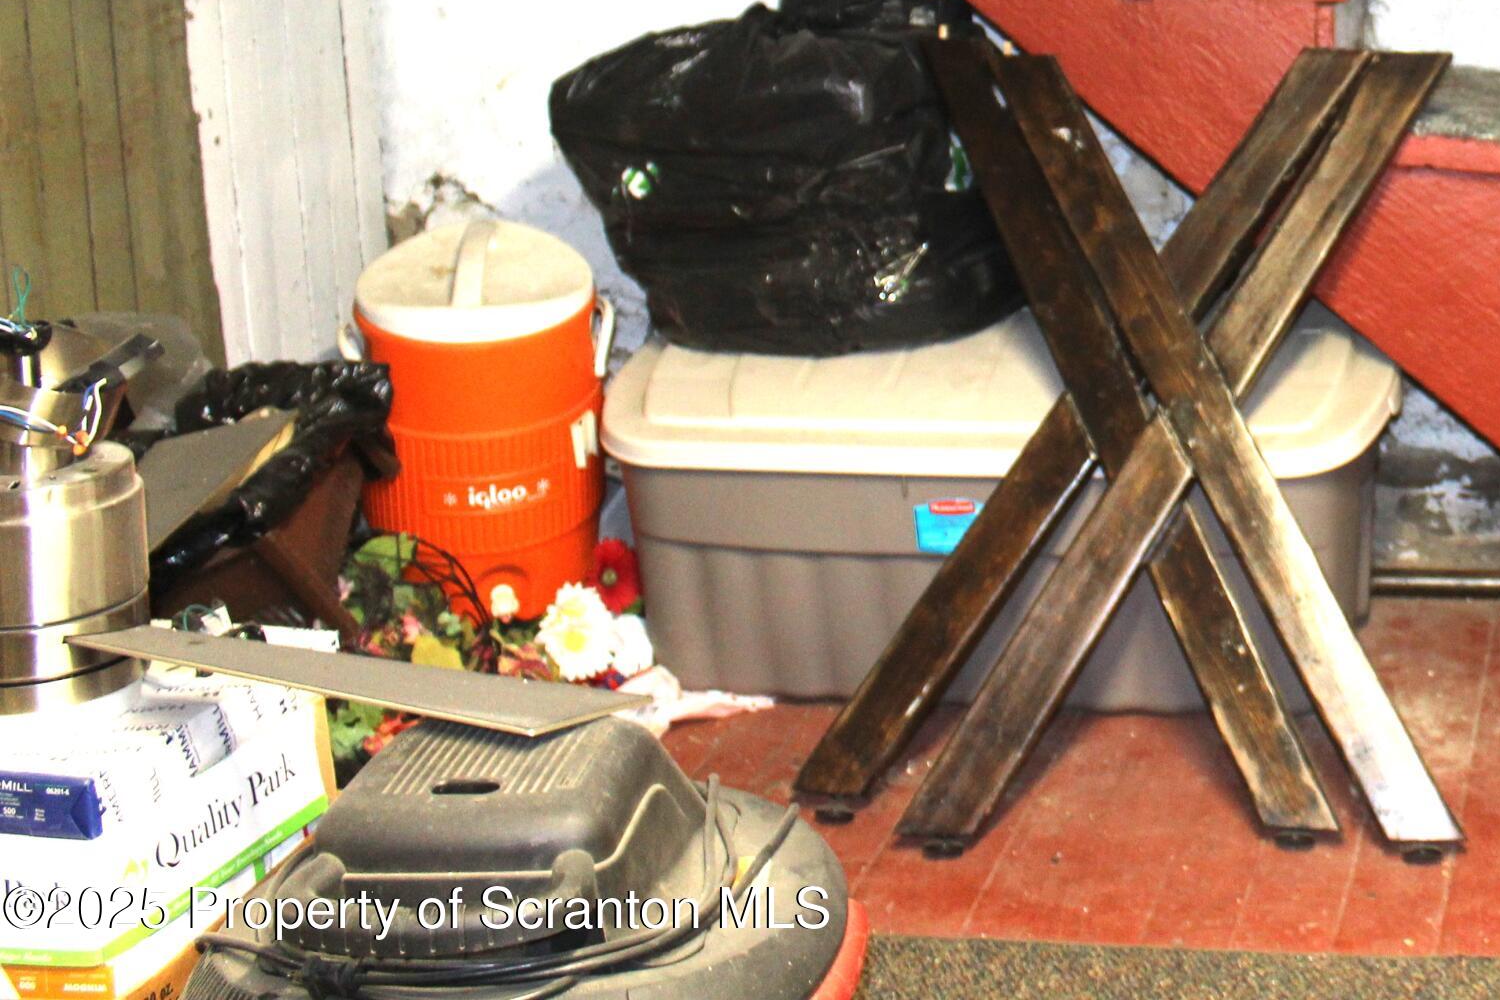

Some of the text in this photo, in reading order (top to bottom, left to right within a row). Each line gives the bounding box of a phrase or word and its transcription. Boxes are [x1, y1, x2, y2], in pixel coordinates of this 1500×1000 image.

[468, 483, 527, 509] igloo
[155, 796, 242, 868] Quality
[247, 753, 296, 808] Park
